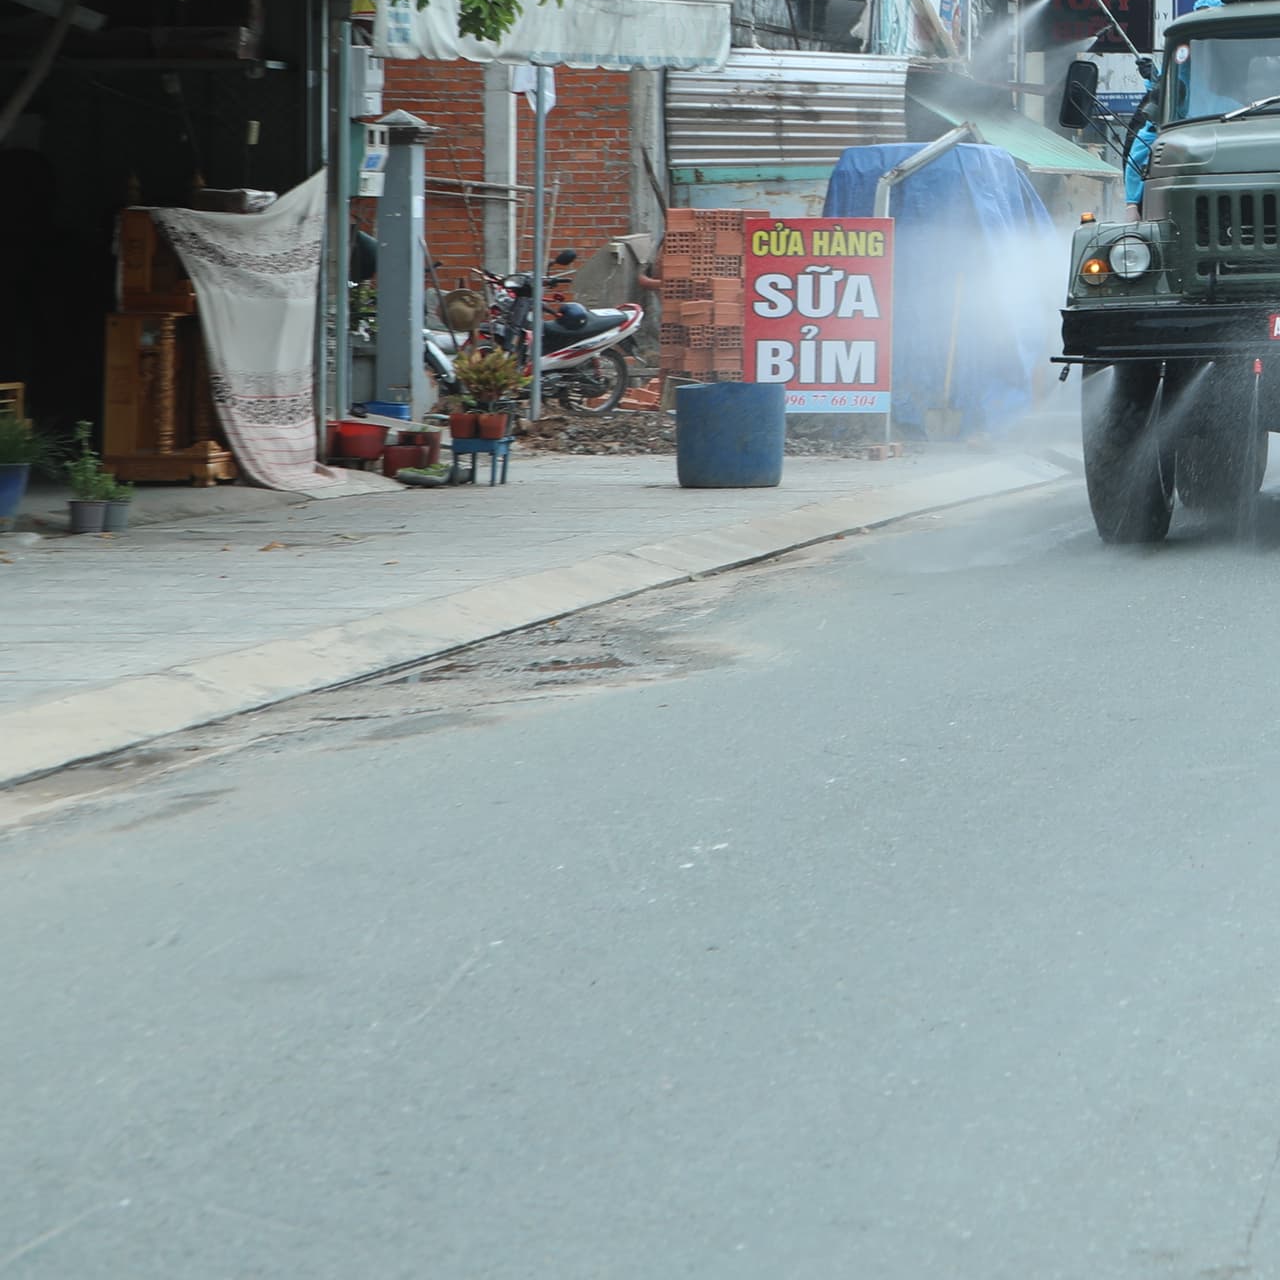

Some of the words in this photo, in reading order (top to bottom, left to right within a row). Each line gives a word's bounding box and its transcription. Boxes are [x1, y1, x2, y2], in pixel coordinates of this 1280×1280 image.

[752, 222, 806, 257] CỬA
[812, 225, 885, 257] HÀNG
[752, 265, 880, 319] SỮA
[756, 325, 877, 385] BỈM
[831, 395, 847, 406] 66
